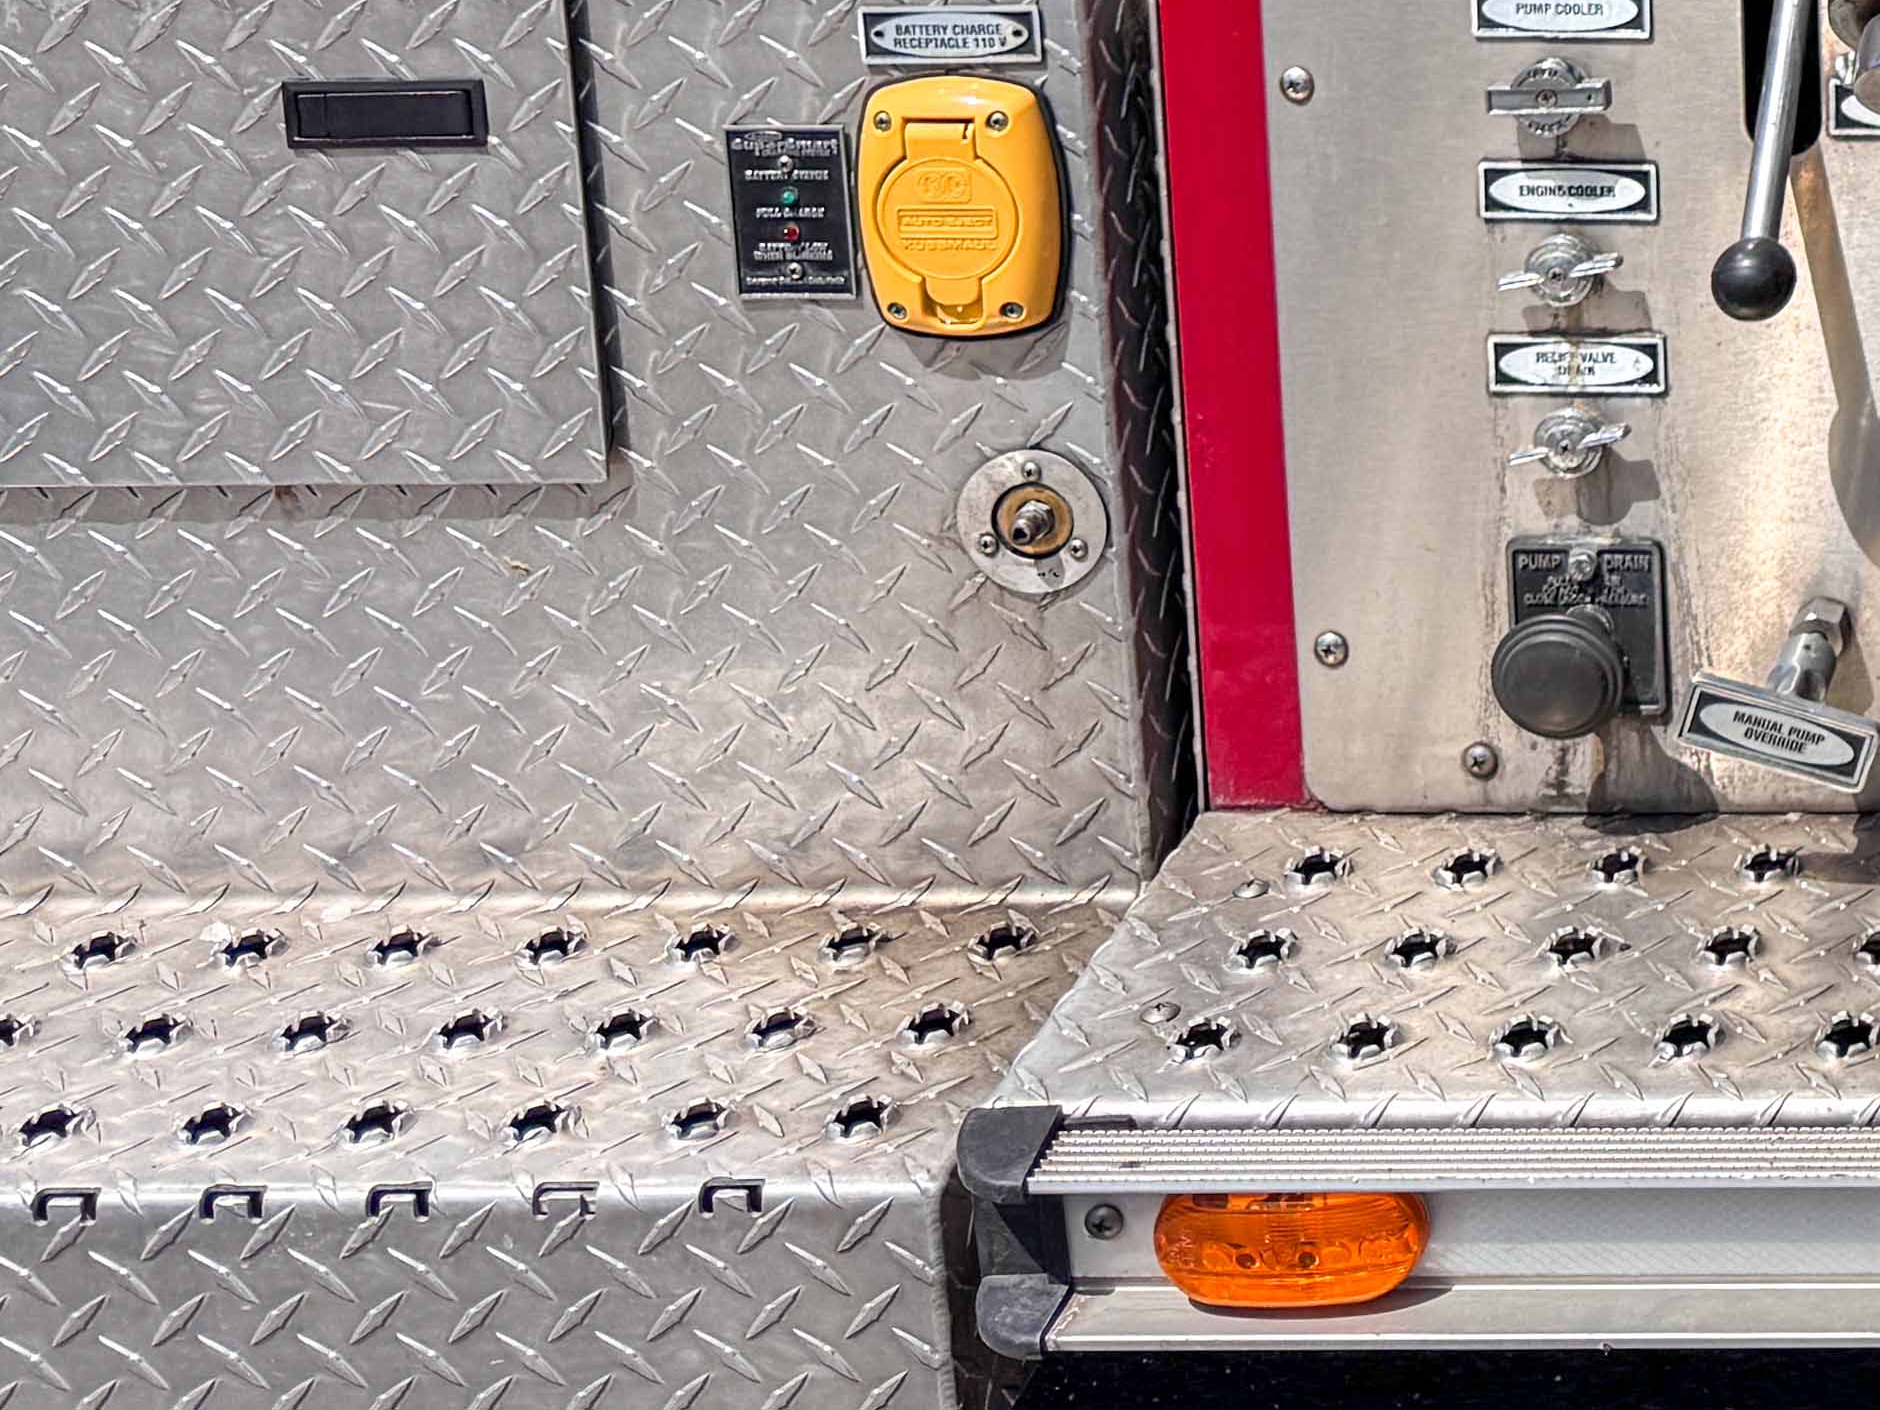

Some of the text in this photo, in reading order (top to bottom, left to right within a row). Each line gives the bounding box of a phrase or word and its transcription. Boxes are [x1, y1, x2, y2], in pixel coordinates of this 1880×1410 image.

[1515, 2, 1604, 16] PUMP COOLER
[895, 23, 1002, 36] BATTERY CHARGE
[893, 36, 969, 49] RECEPTACLE
[974, 36, 996, 49] 110
[1568, 185, 1617, 198] COOLER
[1580, 351, 1617, 364] VALVE
[1518, 553, 1563, 570] PUMP
[1603, 554, 1650, 571] DRAIN
[1732, 710, 1826, 746] MANUAL PUMP
[1744, 726, 1807, 754] OVERRIDE
